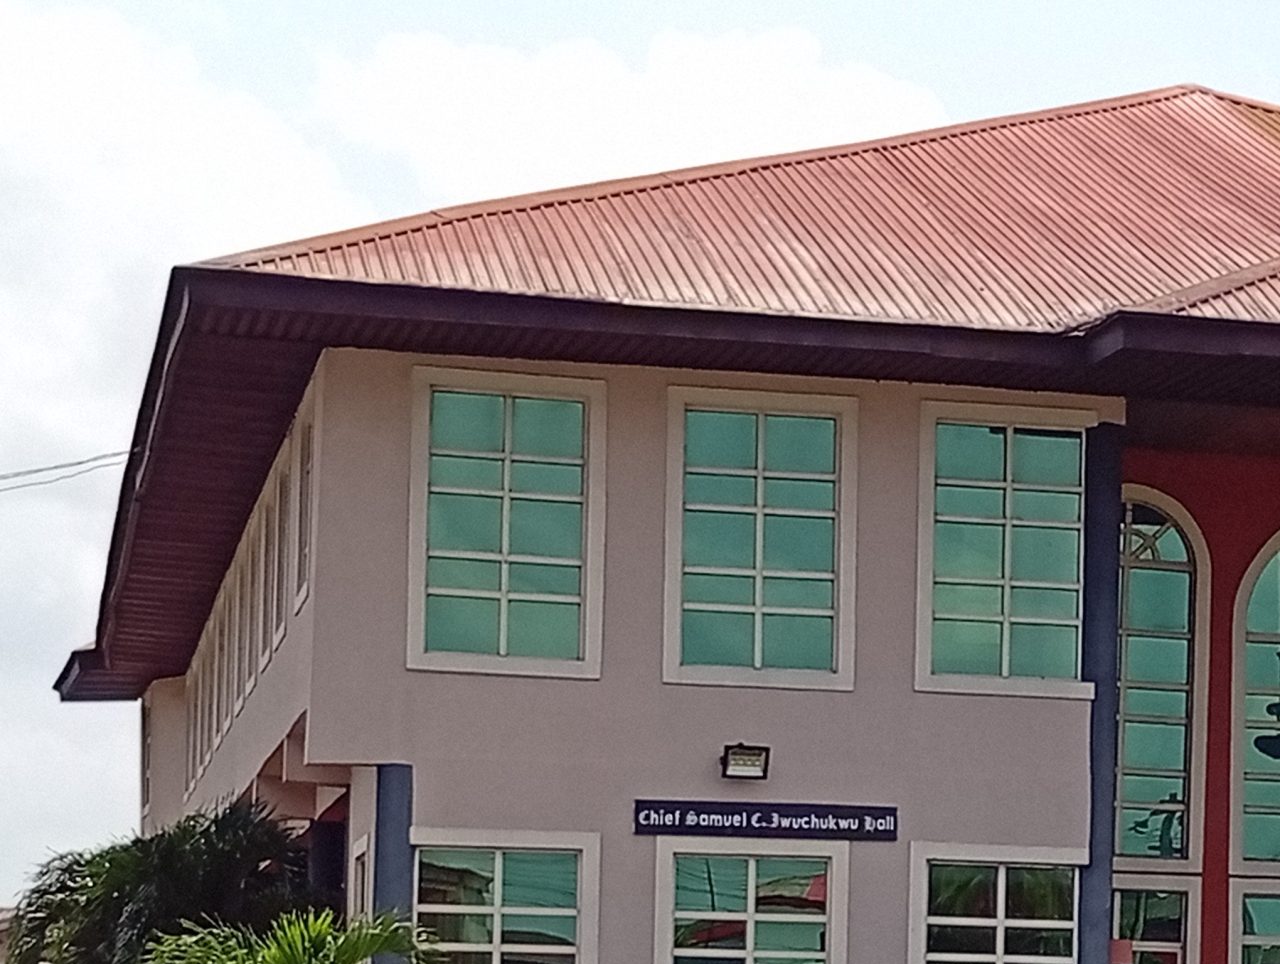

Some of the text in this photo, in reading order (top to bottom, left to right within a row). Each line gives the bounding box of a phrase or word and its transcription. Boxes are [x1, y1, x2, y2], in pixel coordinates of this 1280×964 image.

[638, 809, 681, 826] Chief
[684, 810, 747, 828] Samuel
[863, 815, 895, 833] Hall
